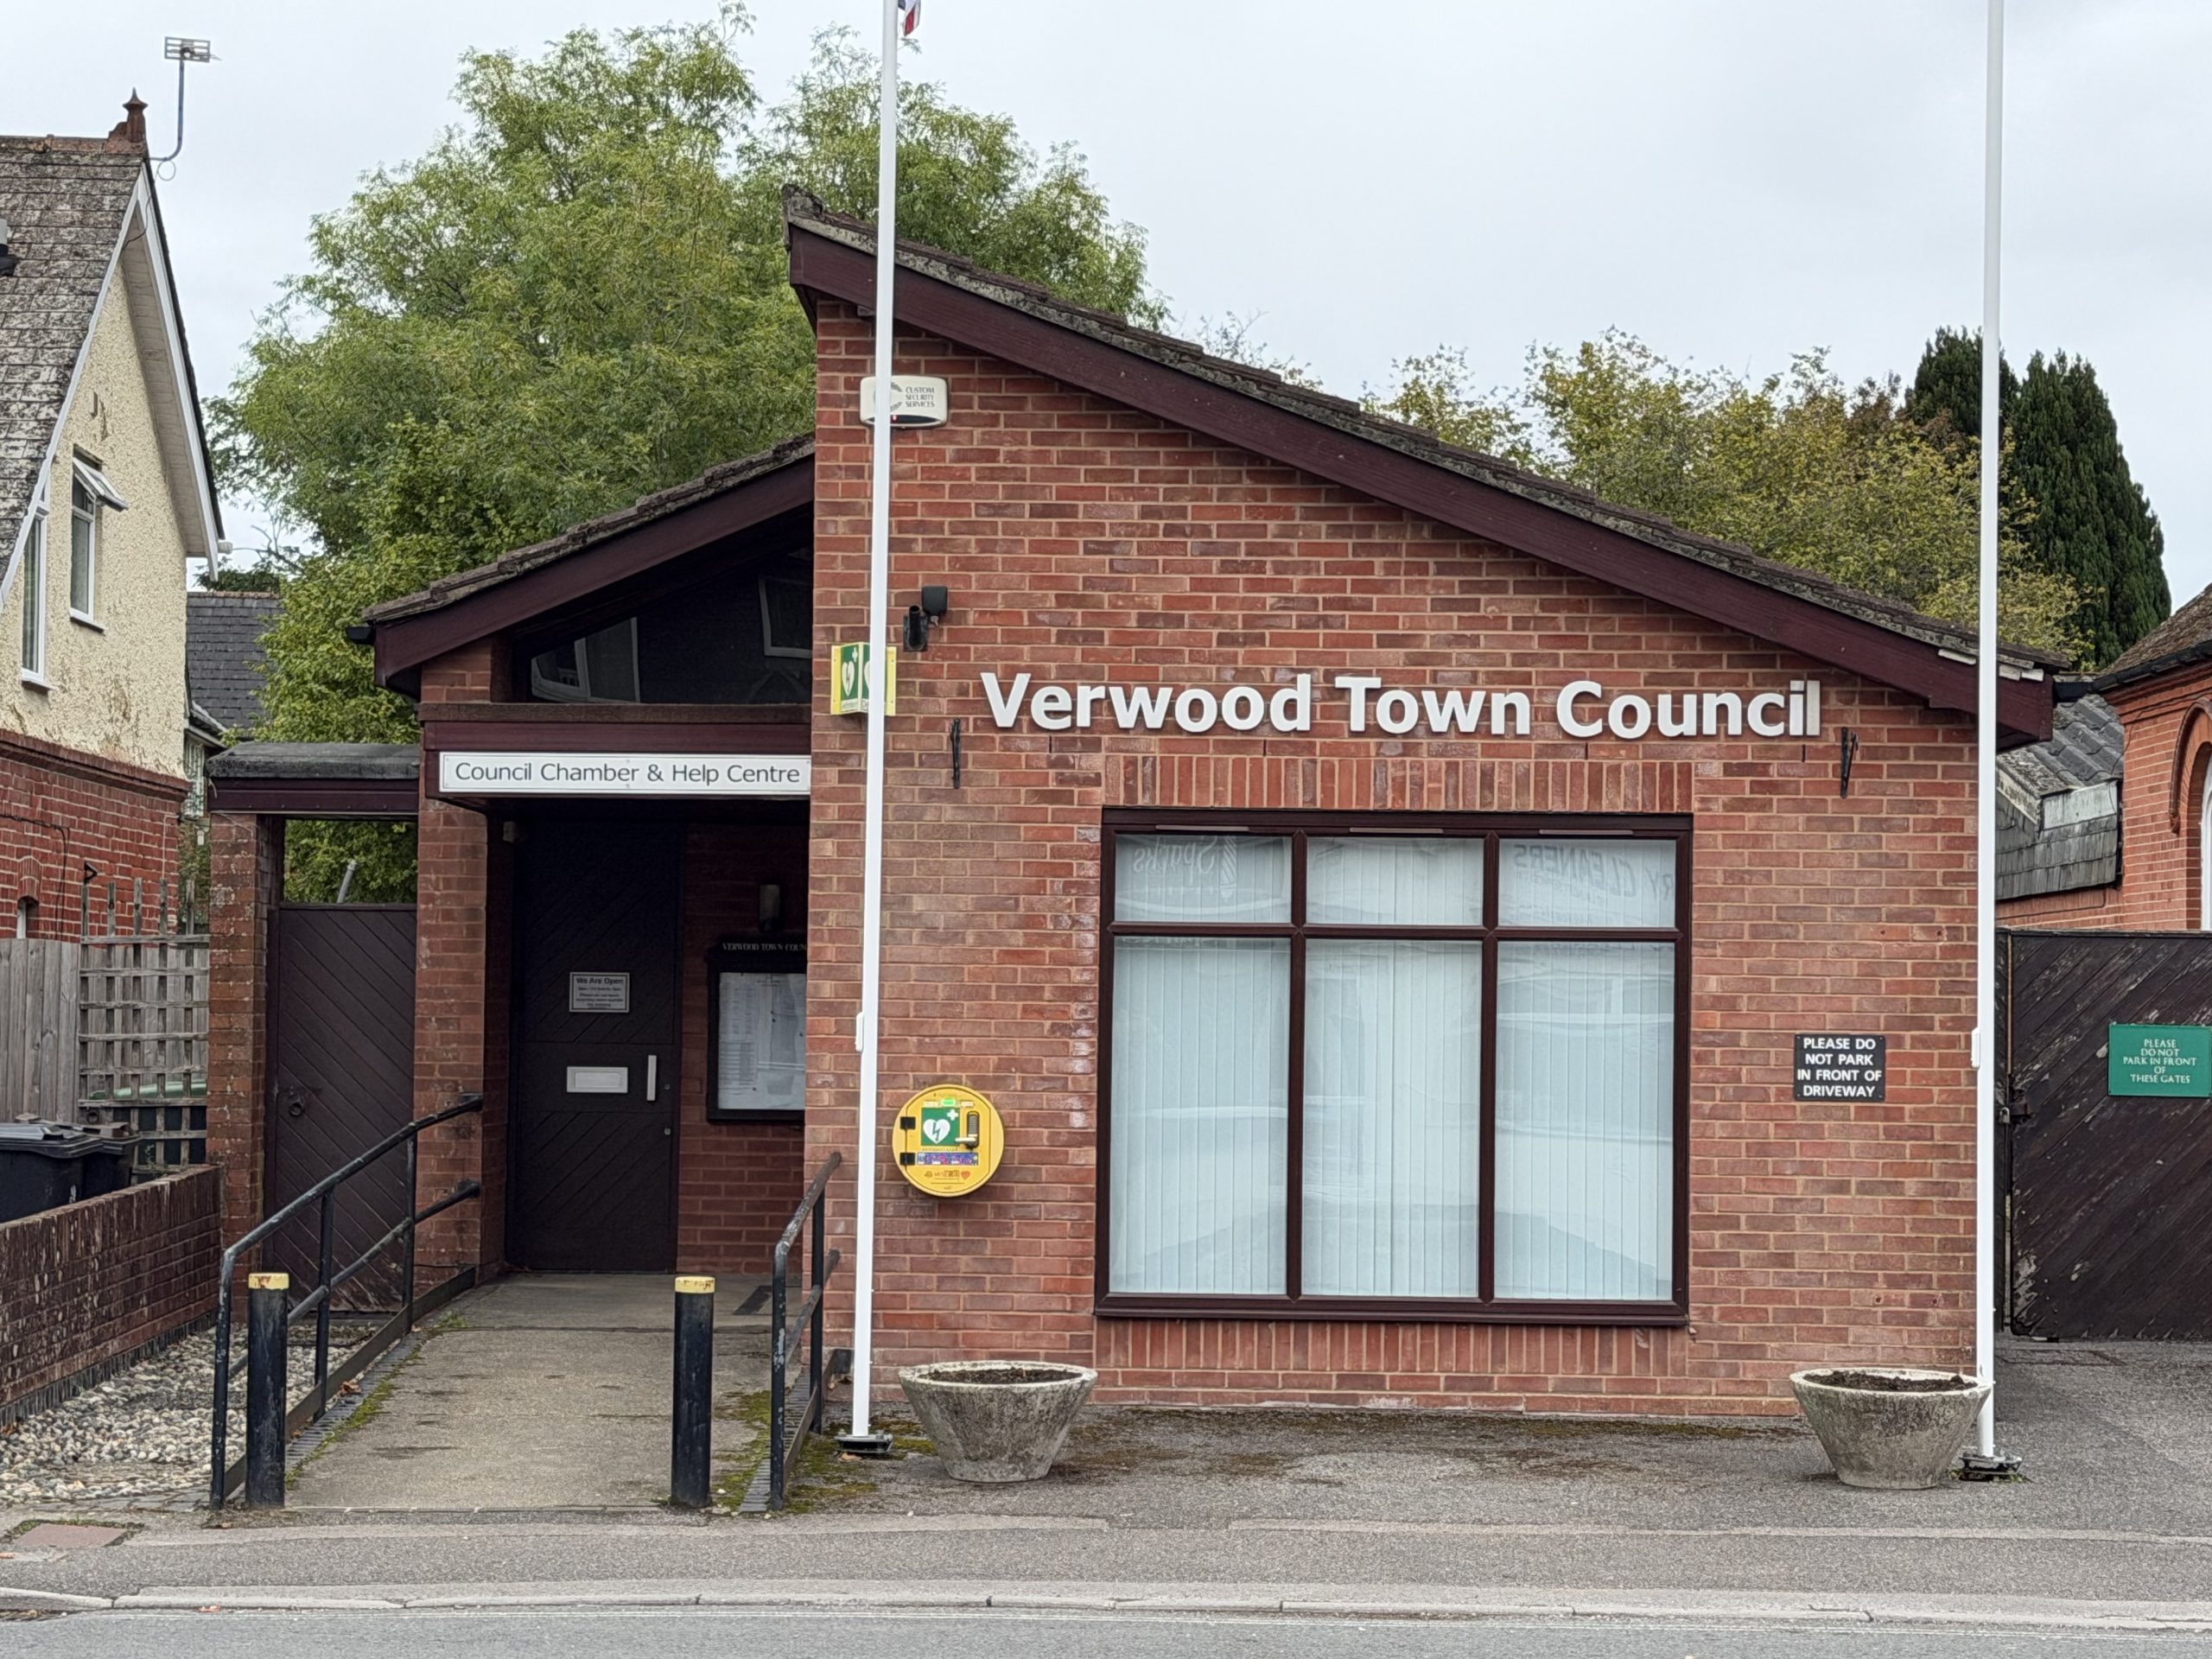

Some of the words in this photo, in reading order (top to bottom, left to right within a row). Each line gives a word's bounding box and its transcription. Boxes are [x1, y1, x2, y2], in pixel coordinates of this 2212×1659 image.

[980, 671, 1312, 733] Verwood
[1334, 676, 1532, 735] Town
[1555, 679, 1821, 740] Council
[455, 762, 532, 781] Council
[540, 763, 640, 782] Chamber
[647, 764, 664, 782] &
[672, 764, 720, 786] Help
[727, 764, 800, 783] Centre
[722, 943, 760, 951] VERWOOD
[1803, 1038, 1851, 1050] PLEASE
[1855, 1039, 1876, 1050] DO
[2144, 1039, 2177, 1049] PLEASE
[2140, 1048, 2157, 1057] DO
[2158, 1048, 2180, 1058] NOT
[1805, 1053, 1834, 1065] NOT
[1838, 1053, 1873, 1066] PARK
[2123, 1056, 2148, 1065] PARK
[2150, 1057, 2161, 1065] IN
[2163, 1057, 2197, 1066] FRONT
[1797, 1069, 1811, 1081] IN
[1815, 1070, 1860, 1082] FRONT
[1864, 1070, 1882, 1082] OF
[2153, 1065, 2167, 1075] OF
[2129, 1074, 2158, 1084] THESE
[2160, 1075, 2190, 1084] GATES
[1802, 1084, 1876, 1097] DRIVEWAY
